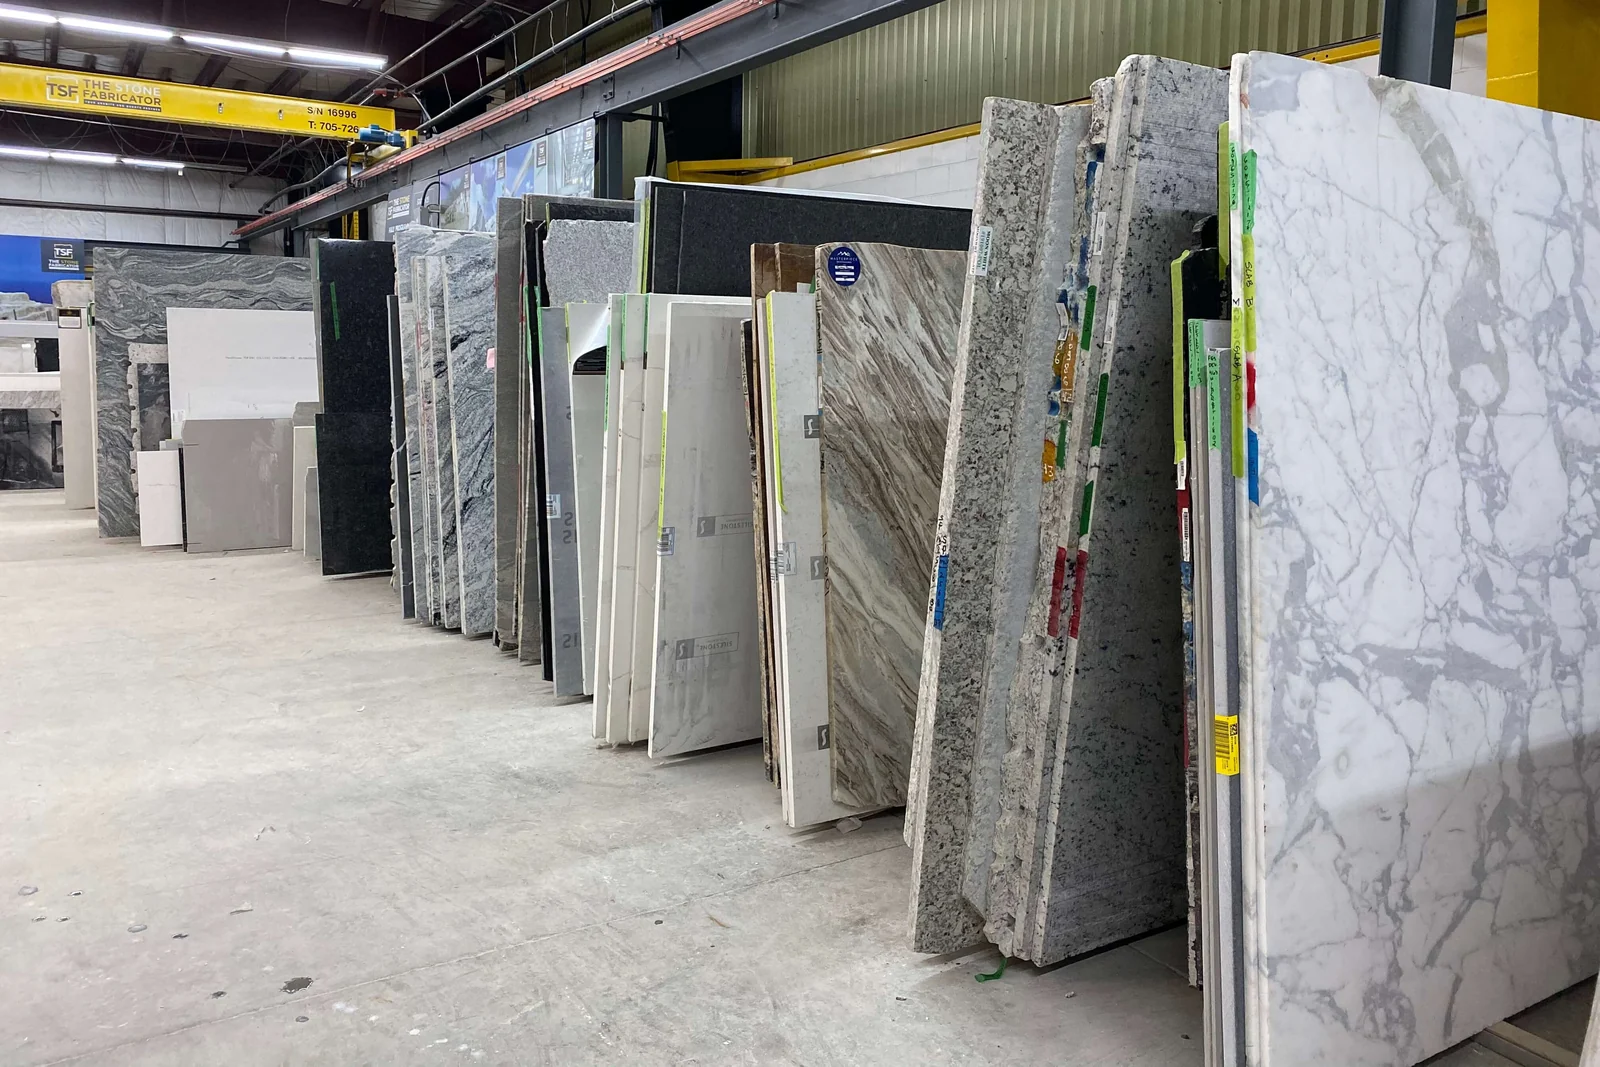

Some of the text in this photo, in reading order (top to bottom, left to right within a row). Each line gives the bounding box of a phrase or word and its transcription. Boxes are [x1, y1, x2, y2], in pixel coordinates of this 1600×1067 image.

[46, 83, 78, 97] TSF
[83, 79, 160, 96] THE STONE
[83, 90, 161, 105] FABRICATOR
[307, 106, 357, 119] S/N 16996
[308, 120, 317, 129] T:
[54, 248, 73, 256] TSF
[700, 640, 733, 650] SILESTONE
